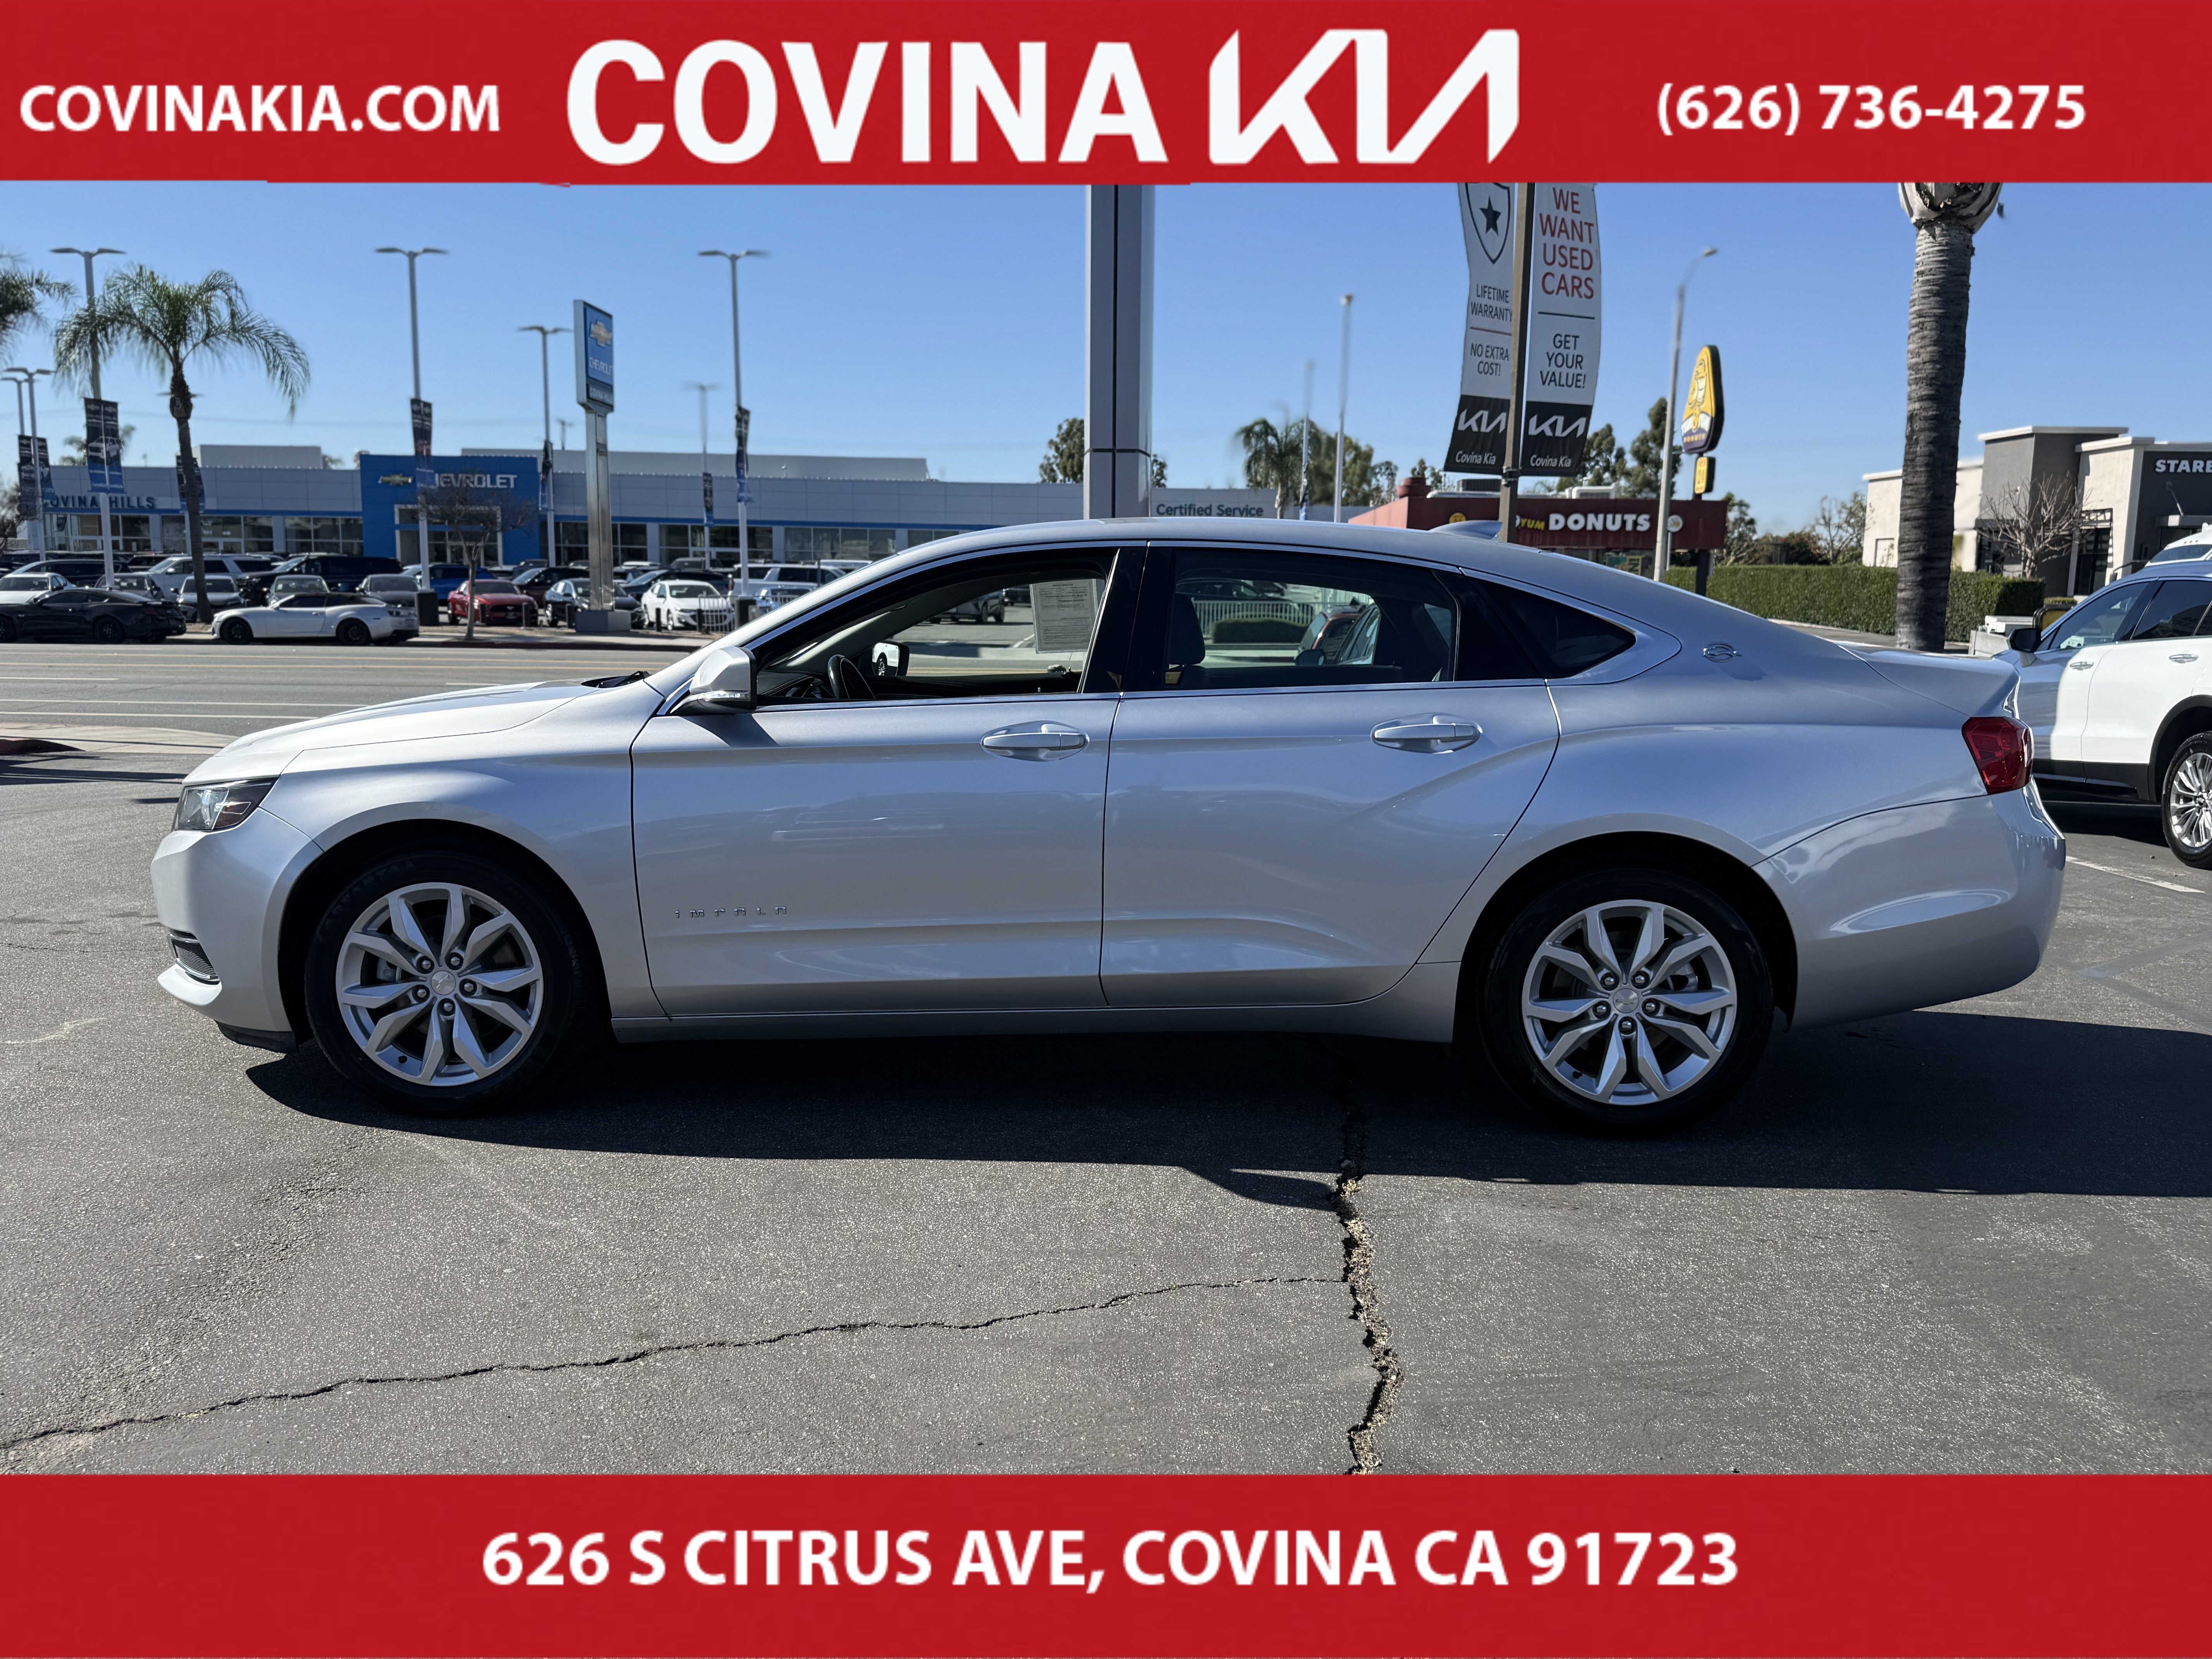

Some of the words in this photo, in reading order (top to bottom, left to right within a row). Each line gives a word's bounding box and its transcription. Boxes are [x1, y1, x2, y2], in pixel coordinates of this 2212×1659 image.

[1553, 187, 1580, 214] WE
[1539, 213, 1594, 244] WANT
[1543, 243, 1593, 271] USED
[1476, 284, 1509, 303] LIFETIME
[1541, 272, 1594, 300] CARS
[1470, 301, 1512, 322] WARRANTY
[1553, 333, 1580, 350] GET
[1470, 343, 1483, 357] NO
[1485, 345, 1509, 361] EXTRA
[1546, 352, 1583, 370] YOUR
[1477, 361, 1501, 376] COST!
[1540, 371, 1586, 389] VALUE!
[1455, 450, 1481, 464] Covina
[1483, 452, 1496, 465] Kia
[1530, 454, 1557, 467] Covina
[1558, 455, 1572, 467] Kia
[43, 496, 98, 507] OVINA
[109, 496, 155, 508] HILLS
[1156, 504, 1212, 516] Certified
[1217, 505, 1264, 516] Service
[1521, 518, 1545, 531] YUM
[1549, 514, 1650, 532] DONUTS
[675, 905, 787, 918] IMPALA
